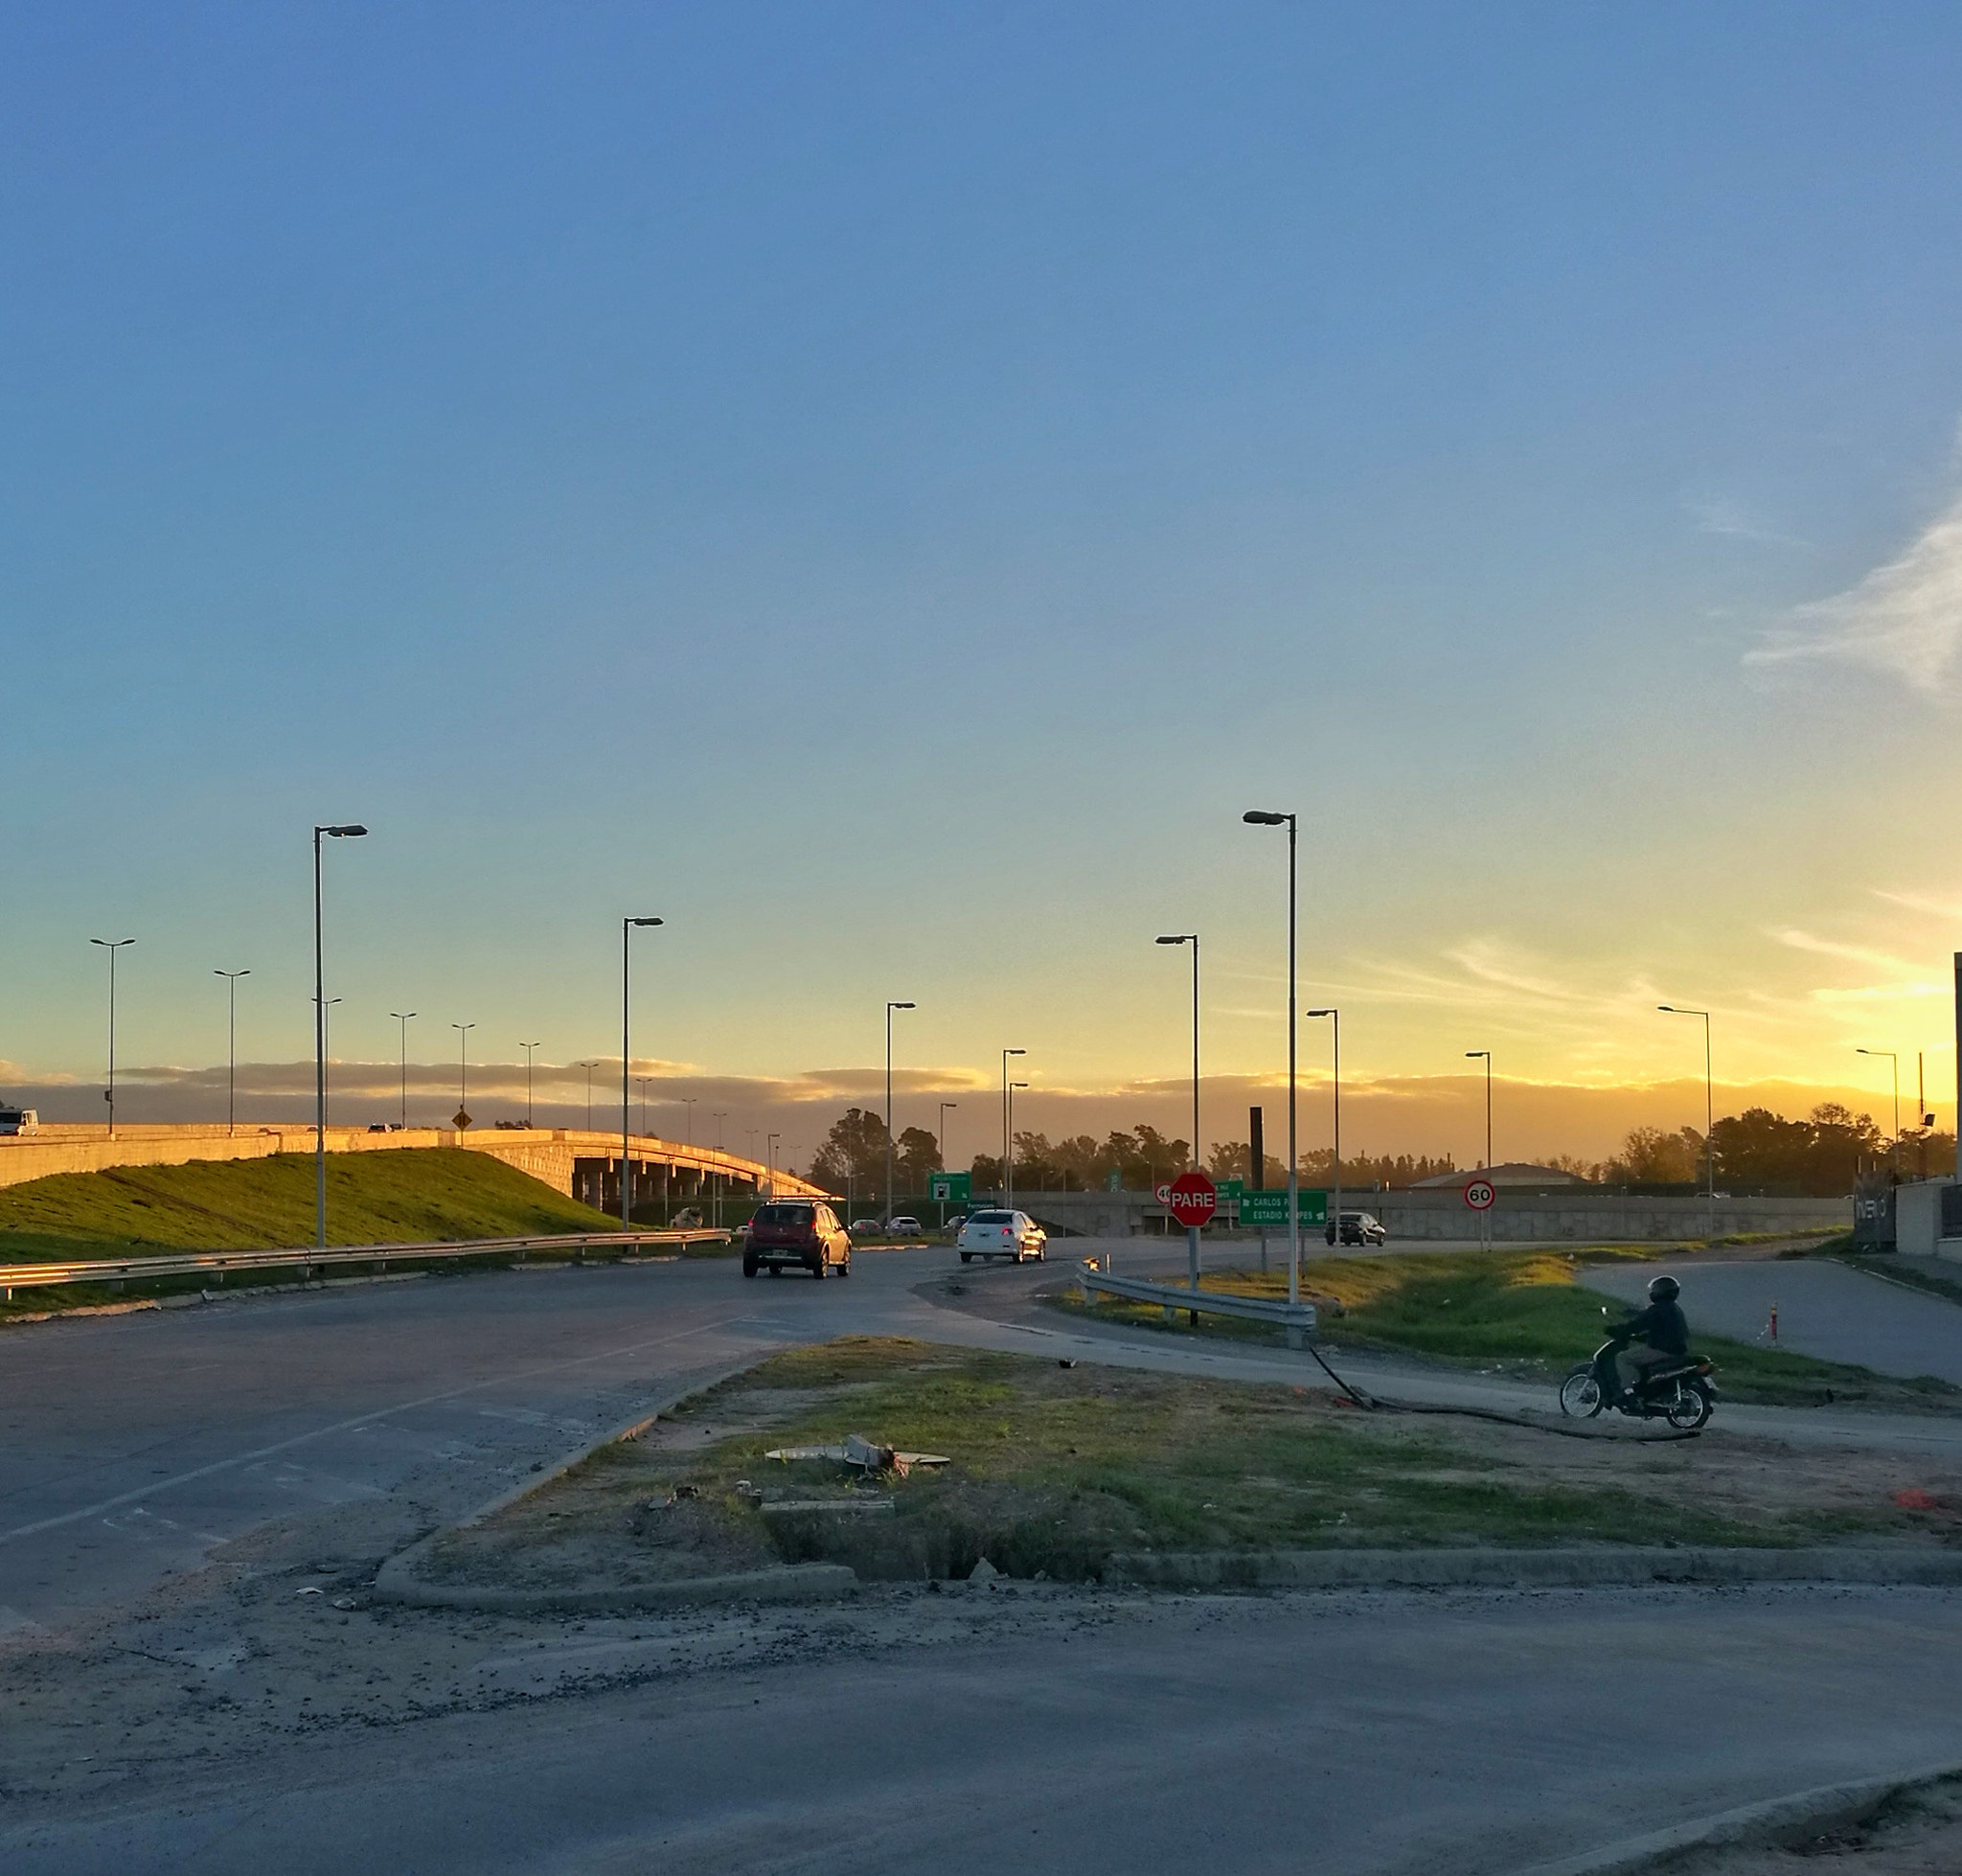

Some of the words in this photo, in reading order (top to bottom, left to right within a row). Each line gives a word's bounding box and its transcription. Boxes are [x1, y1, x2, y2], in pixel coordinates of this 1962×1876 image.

[1172, 1192, 1214, 1207] PARE
[1470, 1189, 1491, 1201] 60
[1253, 1198, 1282, 1206] CARLOS
[1253, 1211, 1283, 1220] ESTADIO
[1285, 1211, 1312, 1220] KPES
